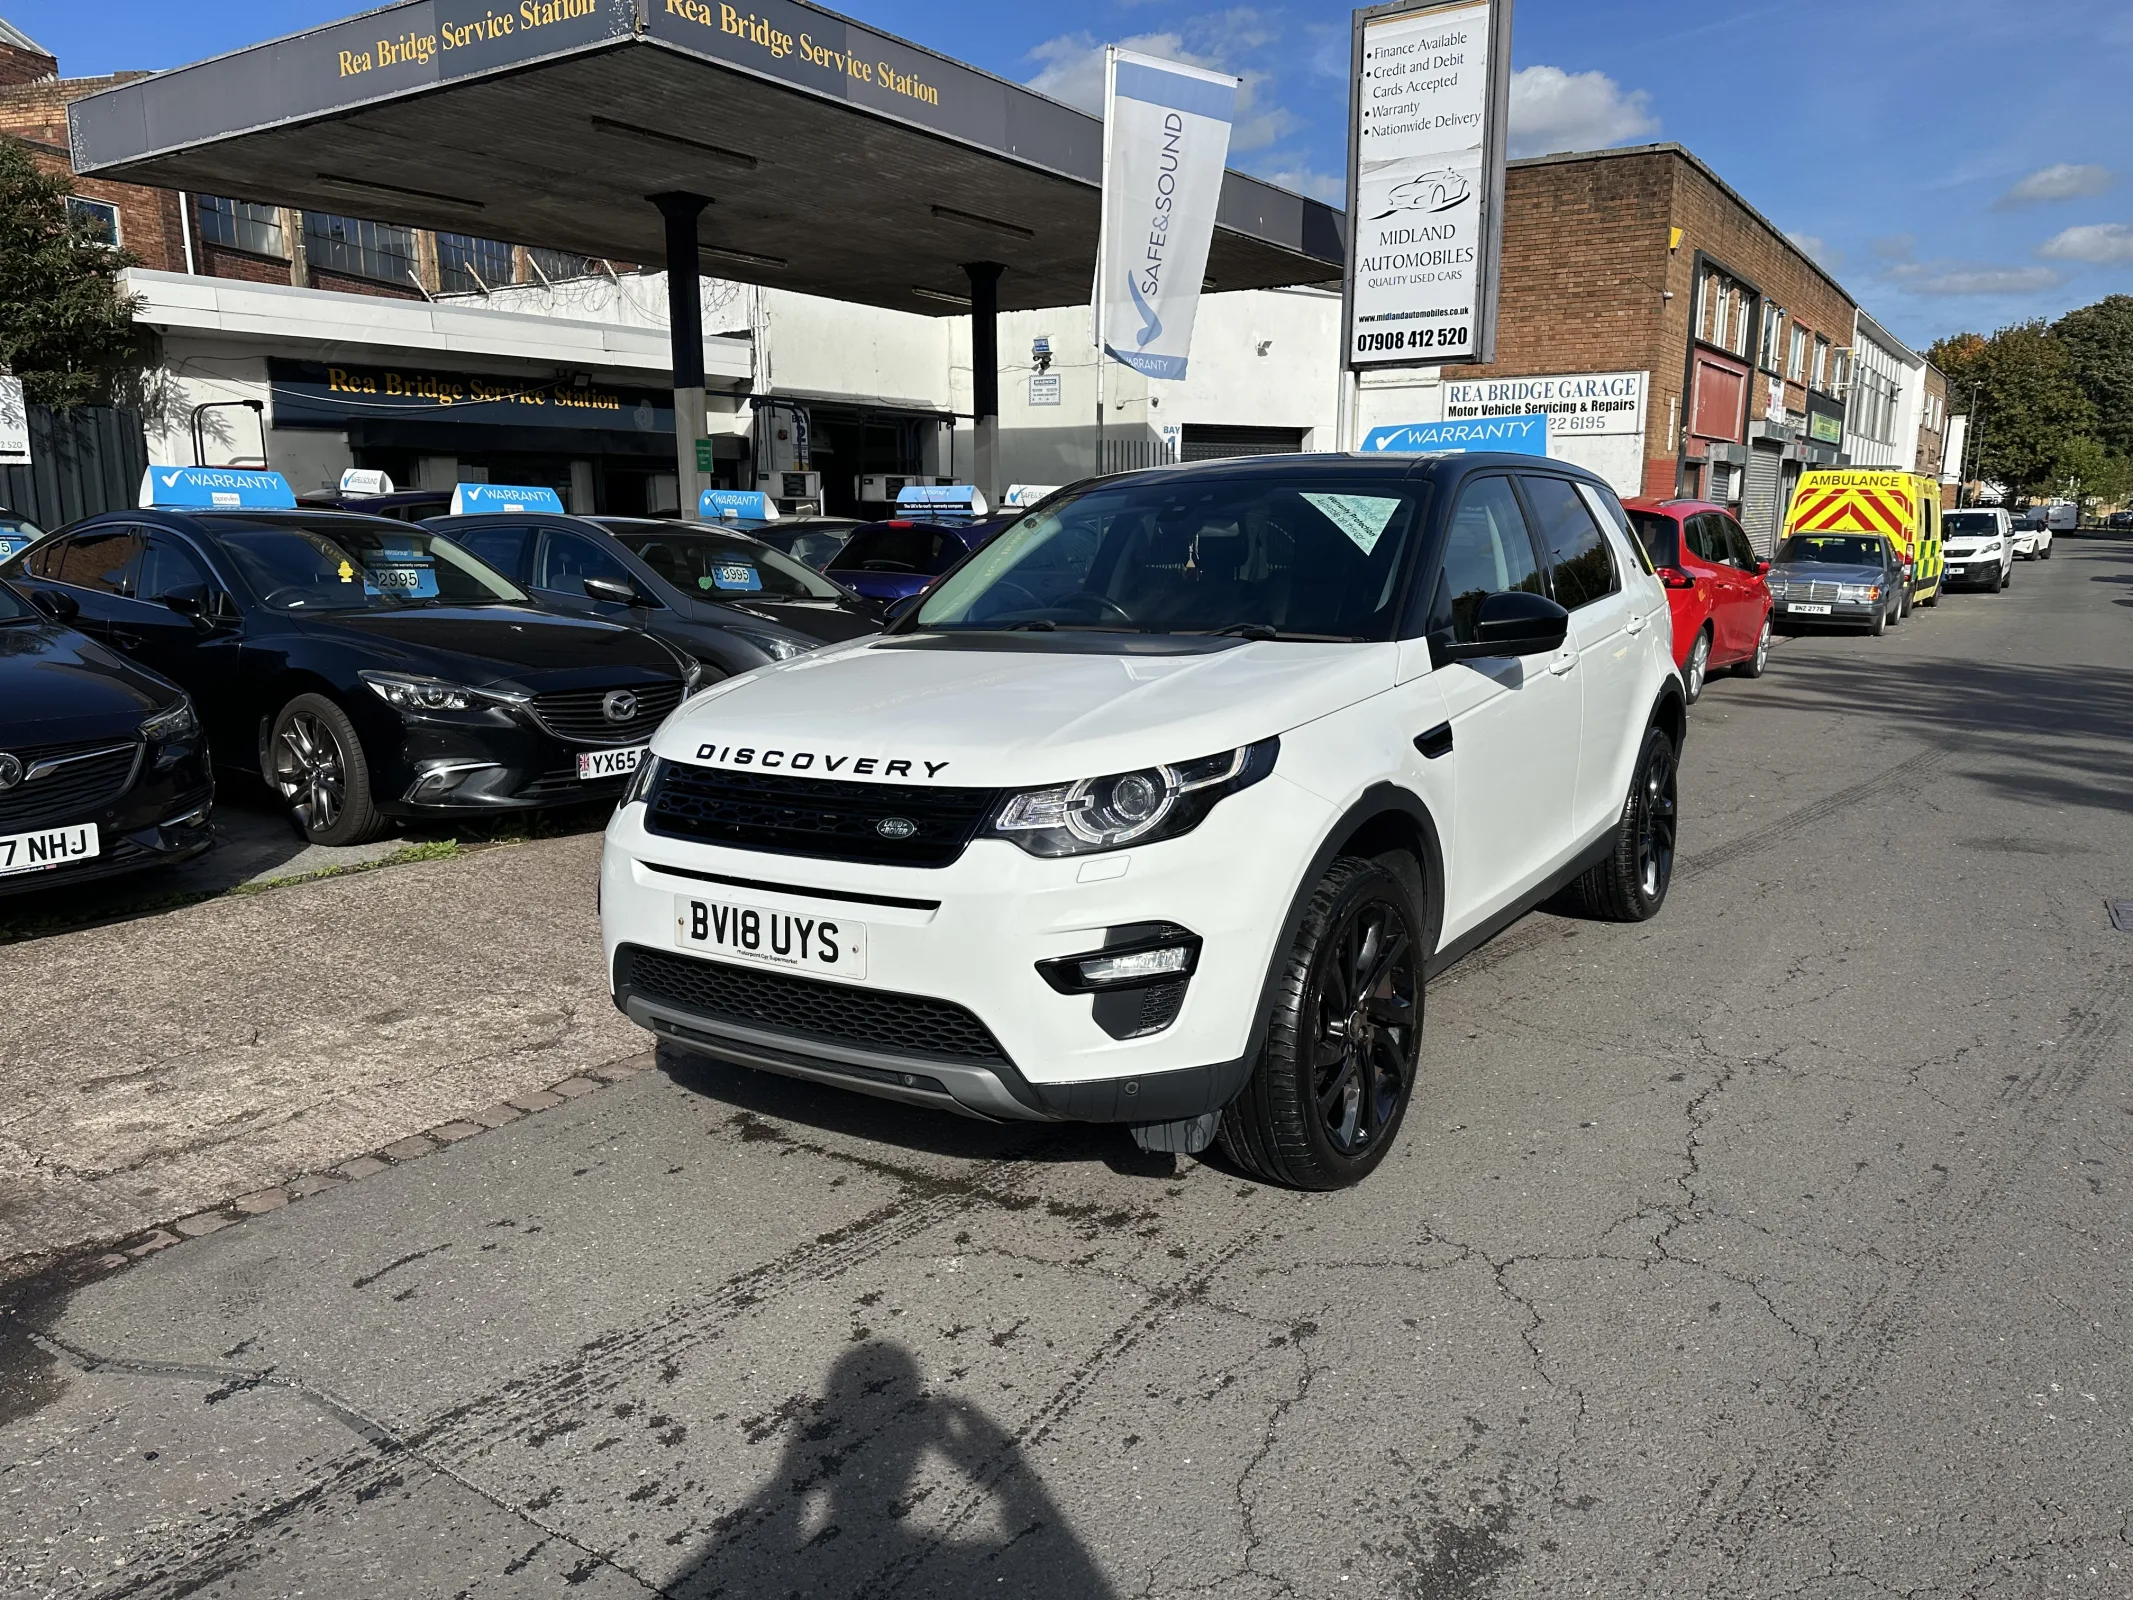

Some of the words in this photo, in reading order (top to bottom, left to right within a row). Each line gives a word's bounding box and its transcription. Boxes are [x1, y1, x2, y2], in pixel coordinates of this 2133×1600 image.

[338, 50, 372, 77] Rea
[376, 33, 437, 66] Bridge
[441, 10, 514, 51] Service
[519, 0, 596, 31] Station
[1374, 43, 1415, 60] Finance
[1417, 31, 1467, 52] Available
[665, 0, 712, 26] Rea
[719, 2, 793, 59] Bridge
[799, 33, 872, 82] Service
[877, 61, 938, 105] Station
[1373, 62, 1406, 79] Credit
[1409, 57, 1430, 73] and
[1433, 52, 1464, 69] Debit
[1373, 82, 1403, 98] Cards
[1405, 72, 1458, 94] Accepted
[1372, 101, 1420, 118] Warranty
[1371, 117, 1431, 138] Nationwide
[1435, 112, 1481, 128] Delivery
[1141, 113, 1183, 296] SAFE&SOUND
[1379, 224, 1456, 246] MIDLAND
[1360, 247, 1474, 272] AUTOMOBILES
[1368, 275, 1407, 288] QUALITY
[1410, 272, 1435, 284] USED
[1437, 270, 1463, 281] CARS
[1358, 306, 1469, 323] www.midlandautomobiles.co.uk
[1357, 332, 1405, 352] 07908
[1407, 329, 1434, 348] 412
[1437, 326, 1468, 346] 520
[328, 368, 377, 394] Rea
[384, 373, 464, 405] Bridge
[470, 379, 546, 405] Service
[554, 386, 620, 410] Station
[1450, 384, 1483, 402] REA
[1488, 379, 1554, 400] BRIDGE
[1558, 378, 1636, 398] GARAGE
[1448, 404, 1478, 417] Motor
[1481, 402, 1521, 415] Vehicle
[1524, 400, 1577, 416] Servicing
[1580, 401, 1587, 411] &
[1592, 399, 1635, 413] Repairs
[1163, 425, 1181, 434] BAY
[1408, 421, 1535, 444] WARRANTY
[1570, 415, 1606, 430] 6195
[7, 441, 23, 449] 520
[184, 472, 279, 490] WARRANTY
[1809, 475, 1900, 487] AMBULANCE
[484, 488, 551, 502] WARRANTY
[715, 494, 760, 506] WARRANTY
[593, 750, 636, 774] YX65
[696, 743, 949, 778] DISCOVERY
[28, 829, 87, 863] NHJ
[690, 900, 761, 950] BV18
[771, 913, 839, 963] UYS
